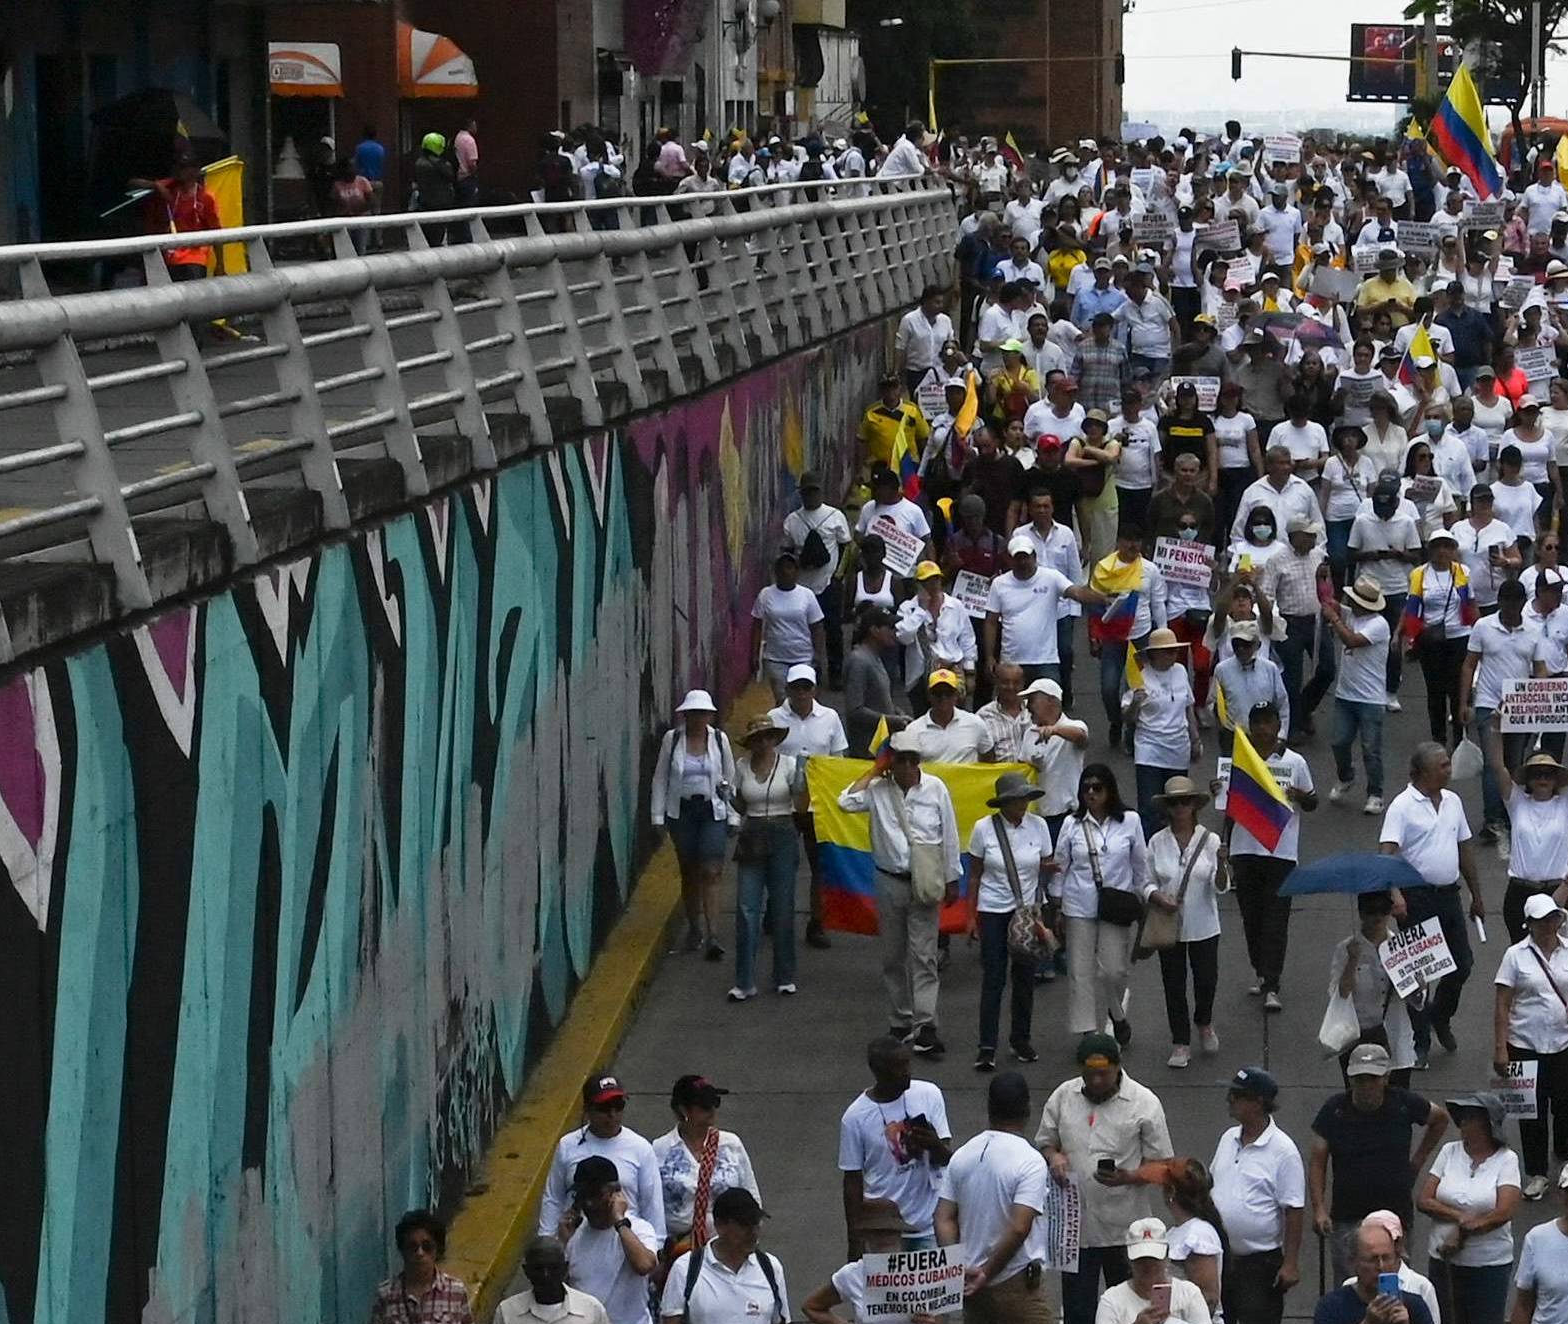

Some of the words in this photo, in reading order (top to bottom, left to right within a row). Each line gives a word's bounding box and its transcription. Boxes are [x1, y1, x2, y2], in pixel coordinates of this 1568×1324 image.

[1515, 682, 1525, 692] UN
[1527, 681, 1567, 692] GOBIERNO
[1505, 693, 1550, 703] ANTISOCIAL
[1511, 704, 1552, 714] DELINQUIR
[1509, 716, 1526, 725] QUE
[1388, 923, 1427, 952] #FUERA
[1407, 934, 1443, 959] CUBANOS
[888, 1249, 948, 1274] #FUERA
[867, 1269, 915, 1288] MÉDICOS
[918, 1265, 963, 1284] CUBANOS
[887, 1291, 899, 1303] EN
[902, 1286, 947, 1302] COLOMBIA
[867, 1302, 907, 1316] TENEMOS
[911, 1301, 927, 1313] LOS
[929, 1294, 961, 1310] MEJORES
